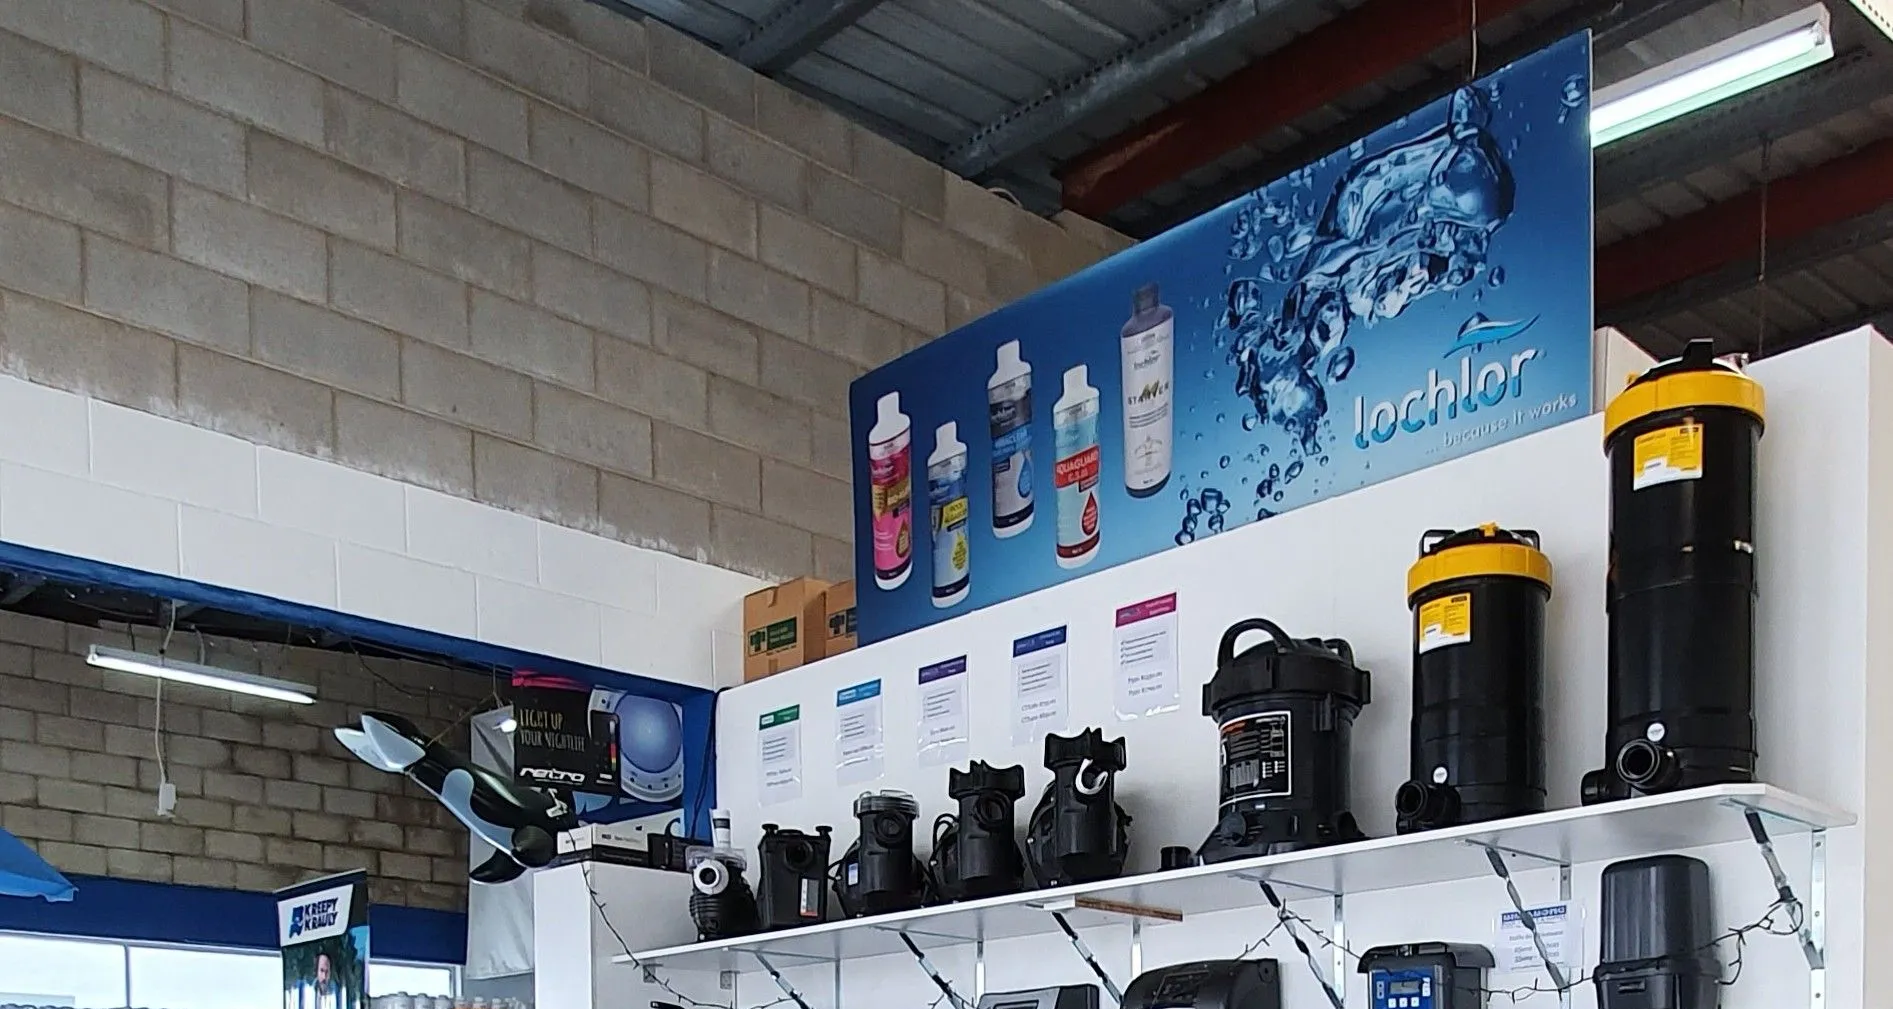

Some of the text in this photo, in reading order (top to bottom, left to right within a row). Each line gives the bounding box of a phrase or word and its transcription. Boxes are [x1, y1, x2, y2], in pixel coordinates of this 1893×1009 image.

[1354, 349, 1539, 449] lochlor
[1513, 410, 1526, 425] it
[1530, 392, 1579, 418] works
[520, 767, 586, 783] retro
[304, 897, 338, 915] KREEPY
[304, 911, 338, 931] KRAULY
